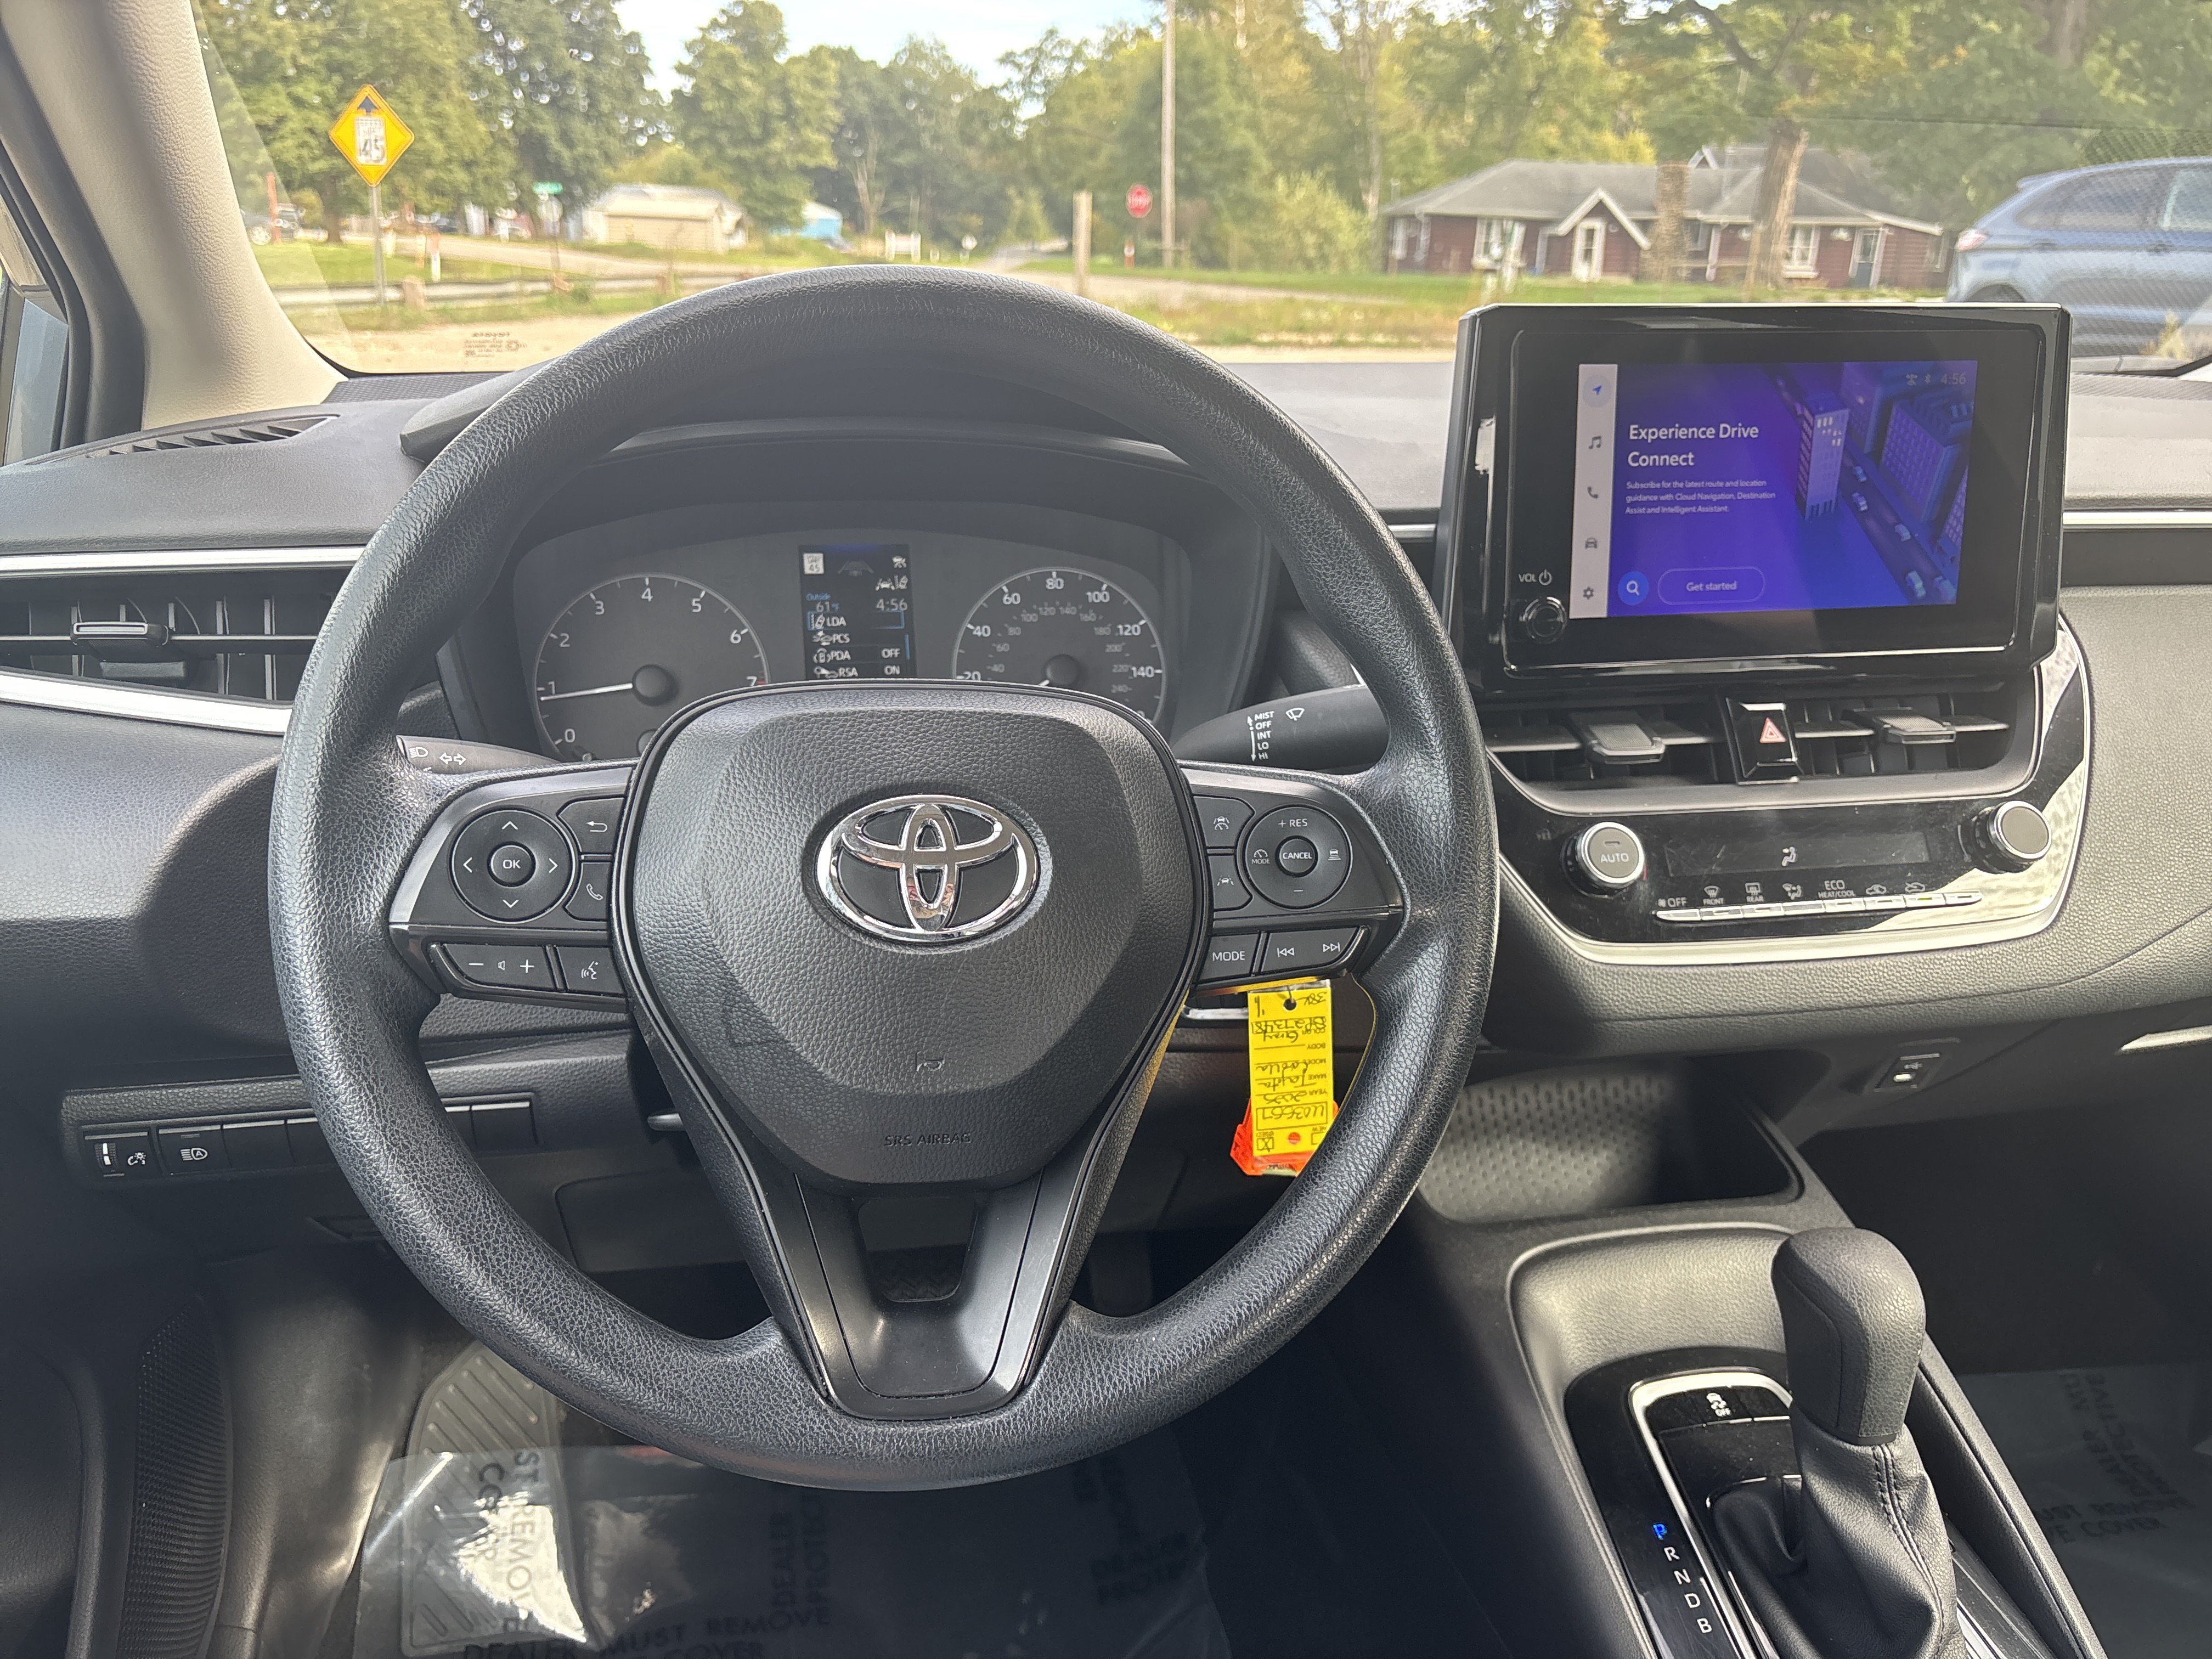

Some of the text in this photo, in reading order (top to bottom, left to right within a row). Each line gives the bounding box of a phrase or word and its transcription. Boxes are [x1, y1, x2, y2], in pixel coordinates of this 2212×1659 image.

[1940, 371, 1967, 385] 4:56
[1629, 422, 1759, 443] Experience Drive
[1628, 452, 1694, 467] Connect
[1626, 481, 1661, 489] Subscribe
[1626, 494, 1657, 503] guidance
[1697, 492, 1735, 501] Navigation,
[1661, 506, 1696, 515] Intelligent
[1046, 578, 1064, 589] 80
[1518, 573, 1537, 583] VOL
[1686, 580, 1737, 592] Get started
[641, 588, 653, 602] 4
[1002, 592, 1020, 605] 60
[1086, 591, 1110, 602] 100
[595, 601, 605, 614] 3
[692, 598, 702, 612] 5
[876, 599, 908, 611] 4:56
[1039, 607, 1056, 616] 120
[1059, 607, 1077, 615] 140
[826, 617, 847, 627] LDA
[1021, 613, 1038, 622] 100
[1080, 613, 1096, 622] 160
[973, 625, 991, 637] 40
[1117, 624, 1141, 636] 120
[560, 633, 570, 647] 2
[730, 629, 741, 644] 6
[832, 634, 850, 643] PCS
[831, 648, 900, 661] PDA OFF
[838, 665, 900, 677] RSA ON
[963, 671, 981, 680] 20
[1131, 665, 1154, 678] 140
[747, 676, 757, 686] 7
[548, 681, 556, 694] 1
[1255, 711, 1274, 721] MIST
[1255, 720, 1272, 730] OFF
[565, 728, 575, 742] 0
[1257, 731, 1271, 740] INT
[1257, 742, 1269, 750] LO
[503, 859, 521, 869] OK
[1600, 853, 1629, 864] AUTO
[1824, 879, 1846, 890] ECO
[1667, 897, 1687, 906] OFF
[1212, 951, 1246, 962] MODE
[884, 1132, 972, 1147] SRS AIRBAG
[515, 1451, 540, 1481] ST
[1652, 1523, 1712, 1633] P R N D B
